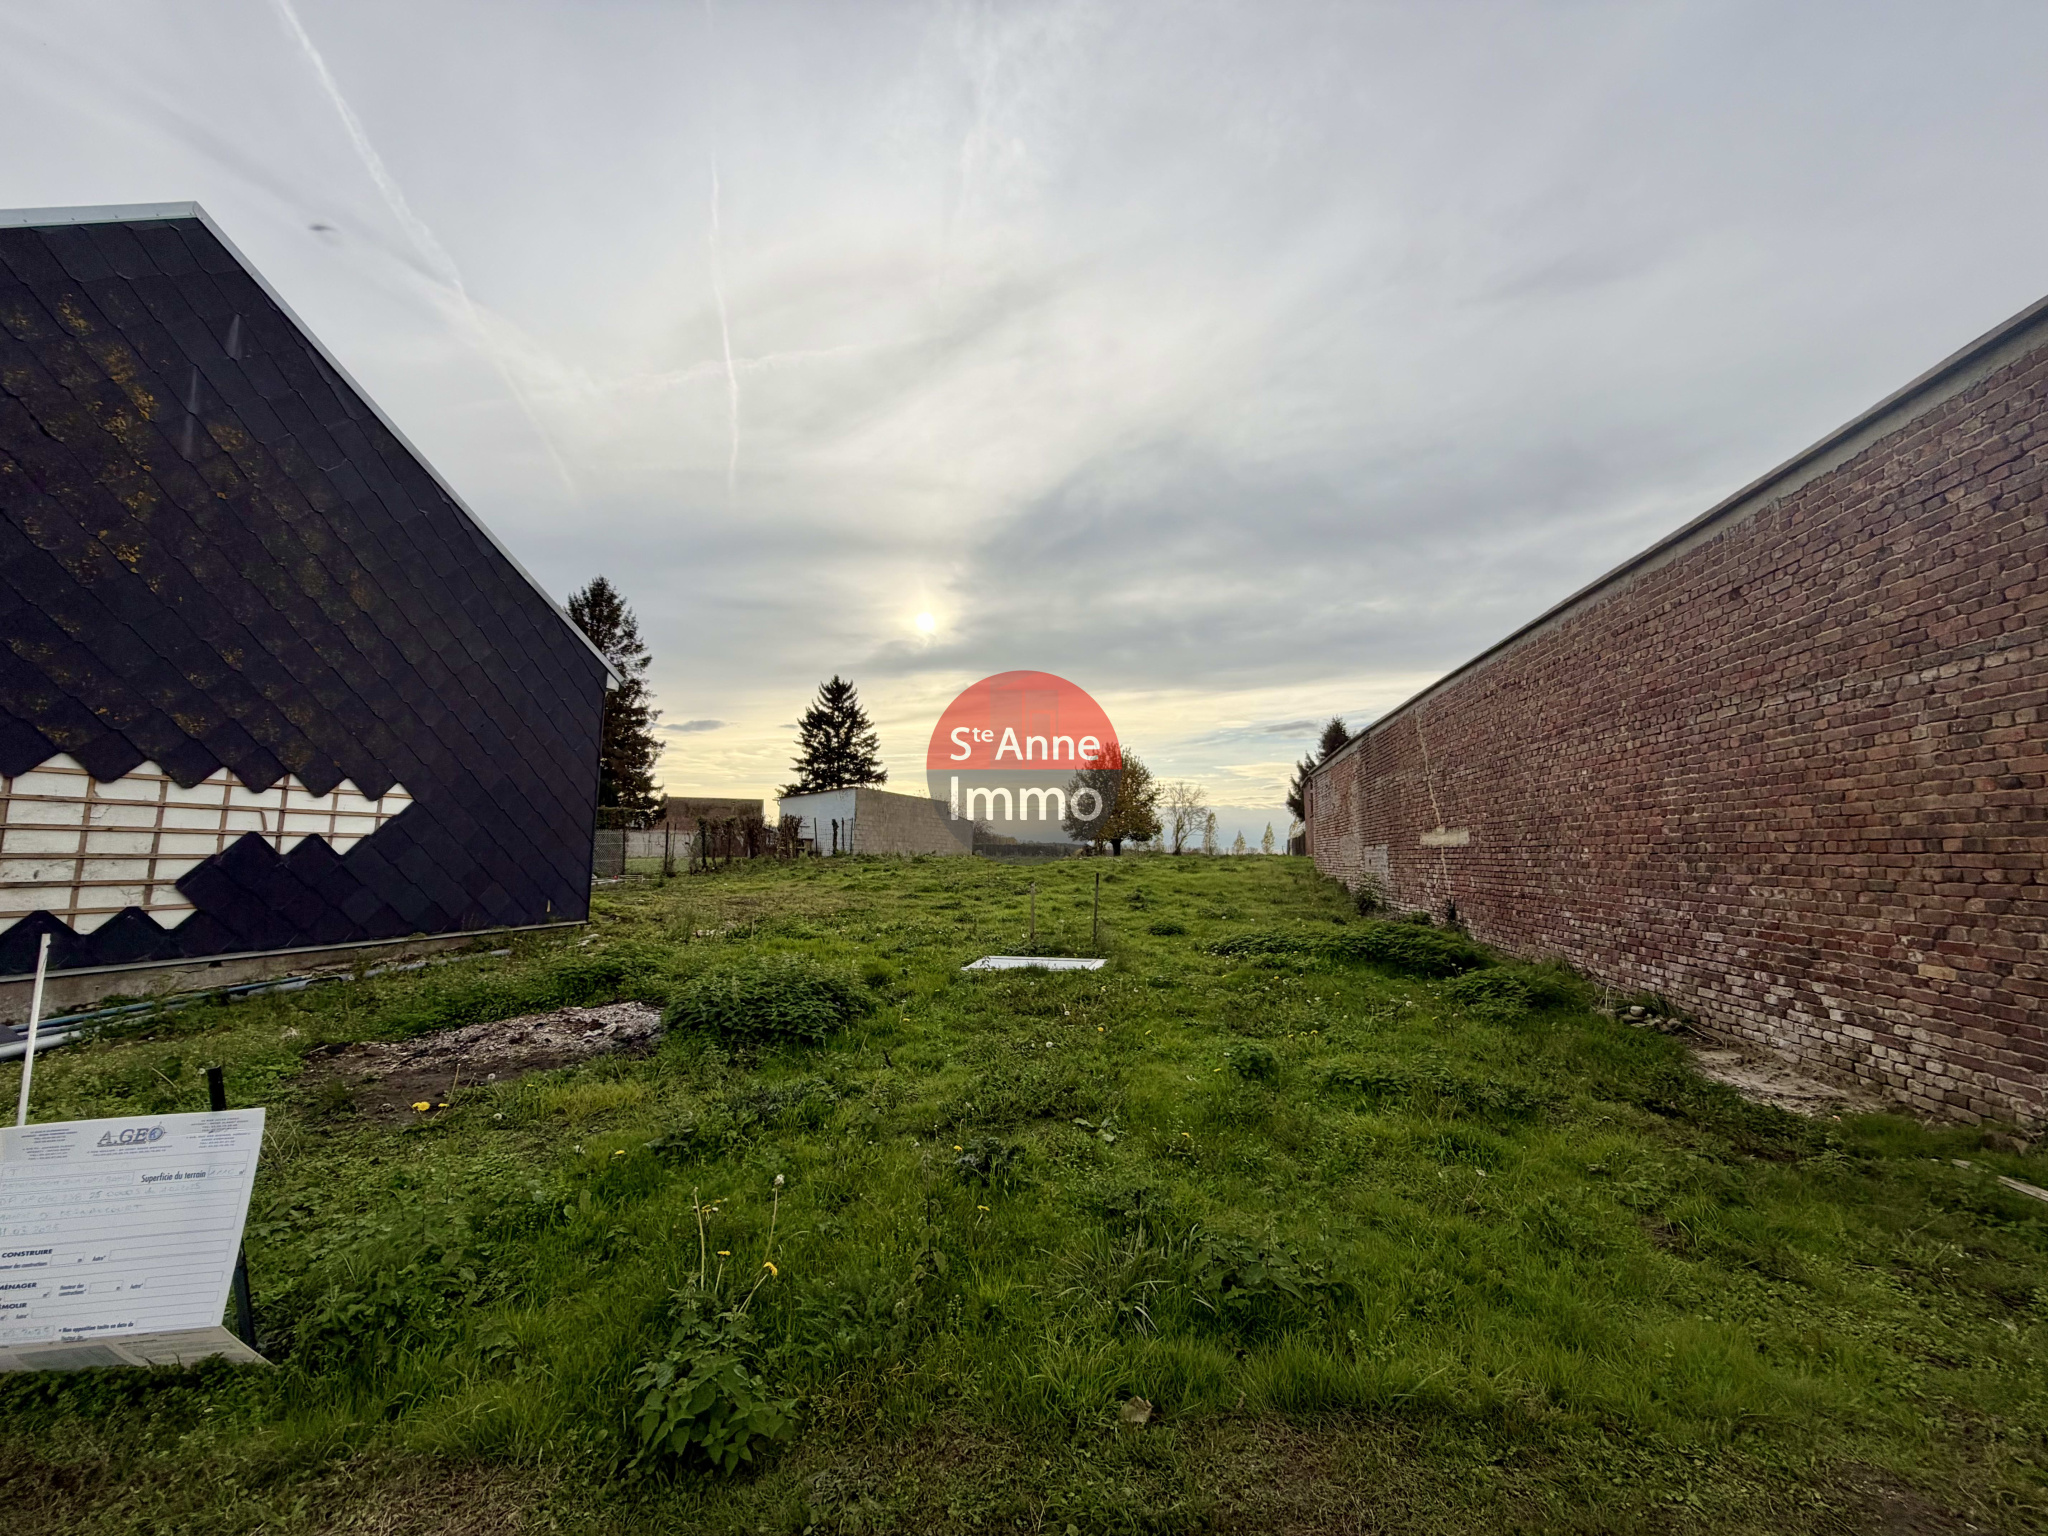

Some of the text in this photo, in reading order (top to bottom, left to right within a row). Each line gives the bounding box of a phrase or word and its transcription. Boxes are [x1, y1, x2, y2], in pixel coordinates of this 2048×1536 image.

[141, 1171, 173, 1183] Superficie
[174, 1170, 184, 1180] du
[184, 1169, 206, 1179] terrain
[1, 1248, 53, 1258] CONSTRUIRE
